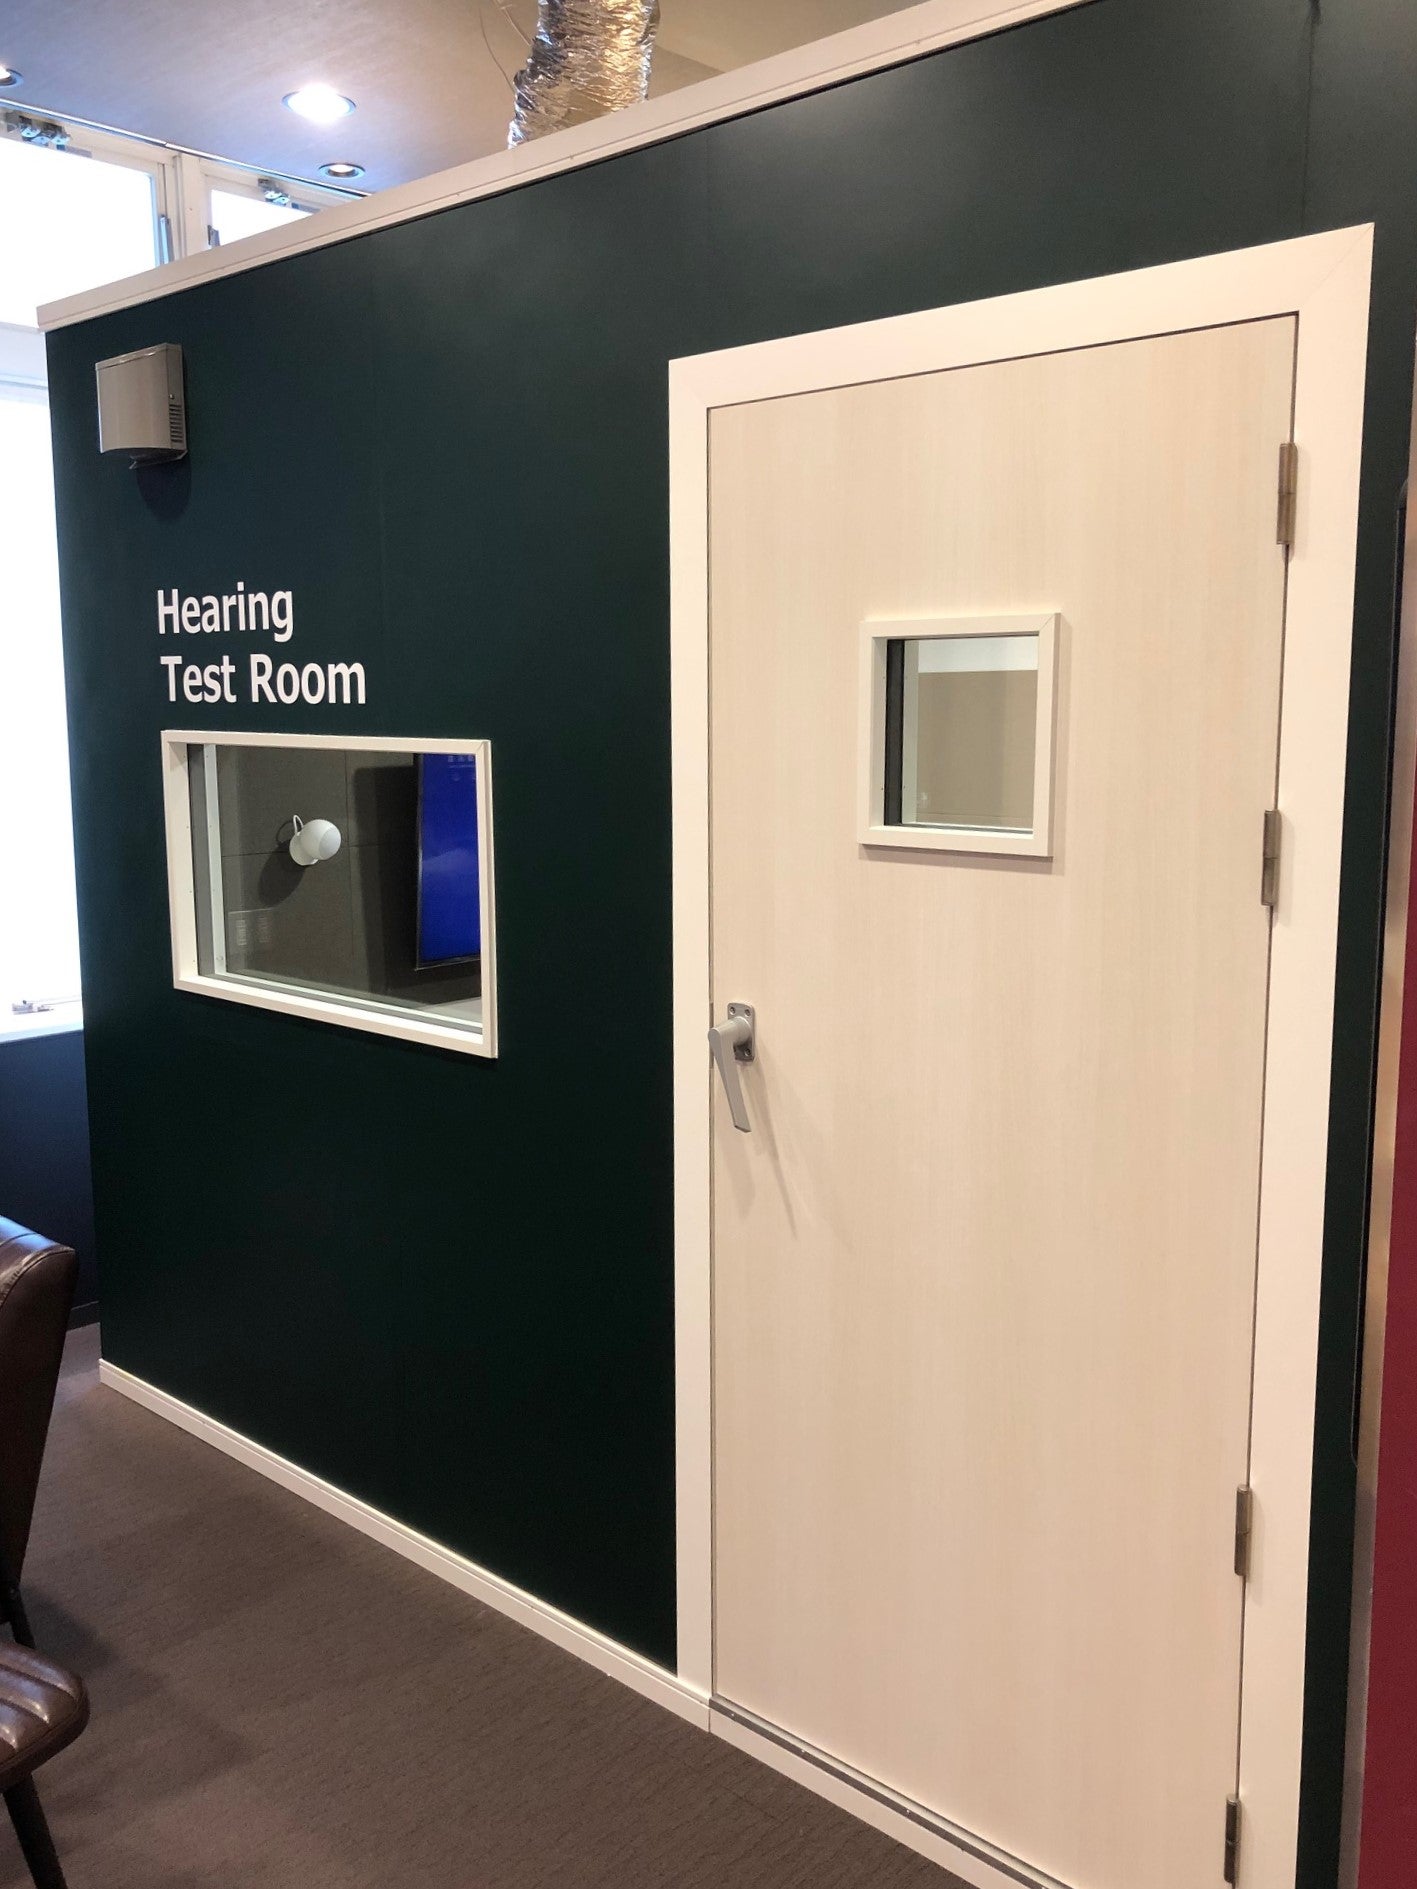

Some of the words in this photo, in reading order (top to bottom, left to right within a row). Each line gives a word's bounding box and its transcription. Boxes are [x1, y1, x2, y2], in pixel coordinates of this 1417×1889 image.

[157, 581, 294, 643] Hearing
[160, 654, 237, 704] Test
[249, 653, 366, 705] Room
